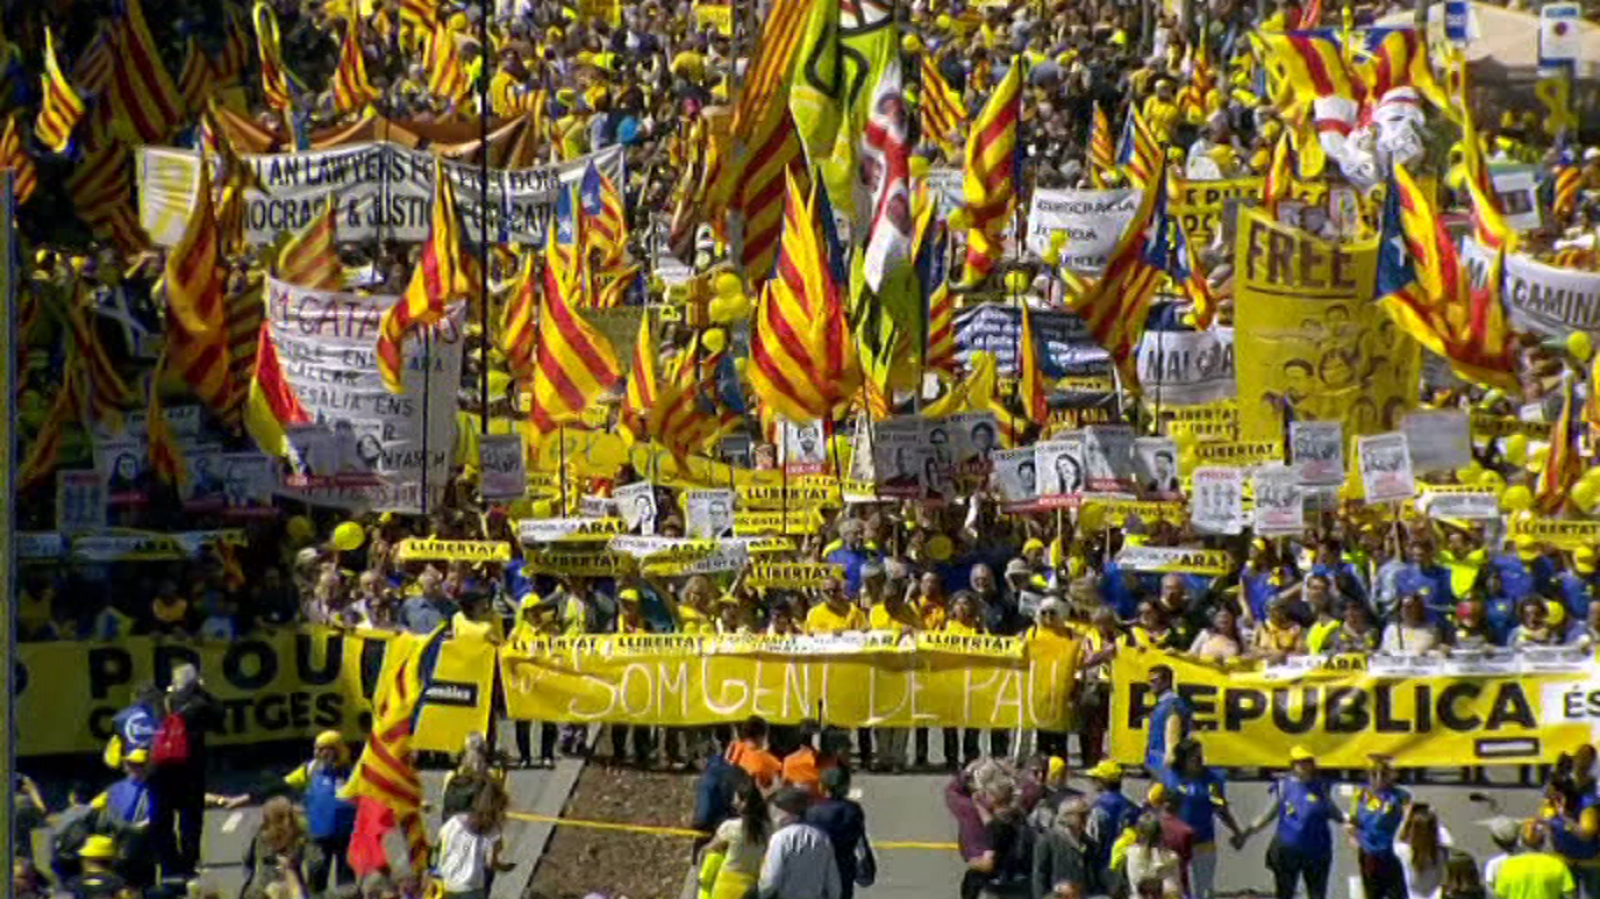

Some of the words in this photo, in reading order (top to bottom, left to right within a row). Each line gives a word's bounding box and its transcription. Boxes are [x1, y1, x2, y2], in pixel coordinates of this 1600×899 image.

[1248, 220, 1356, 295] FREE
[410, 541, 497, 556] LLIBERTAT
[567, 655, 690, 719] SOM
[701, 648, 832, 722] GENT
[867, 660, 941, 724] DE
[960, 656, 1060, 726] PAU
